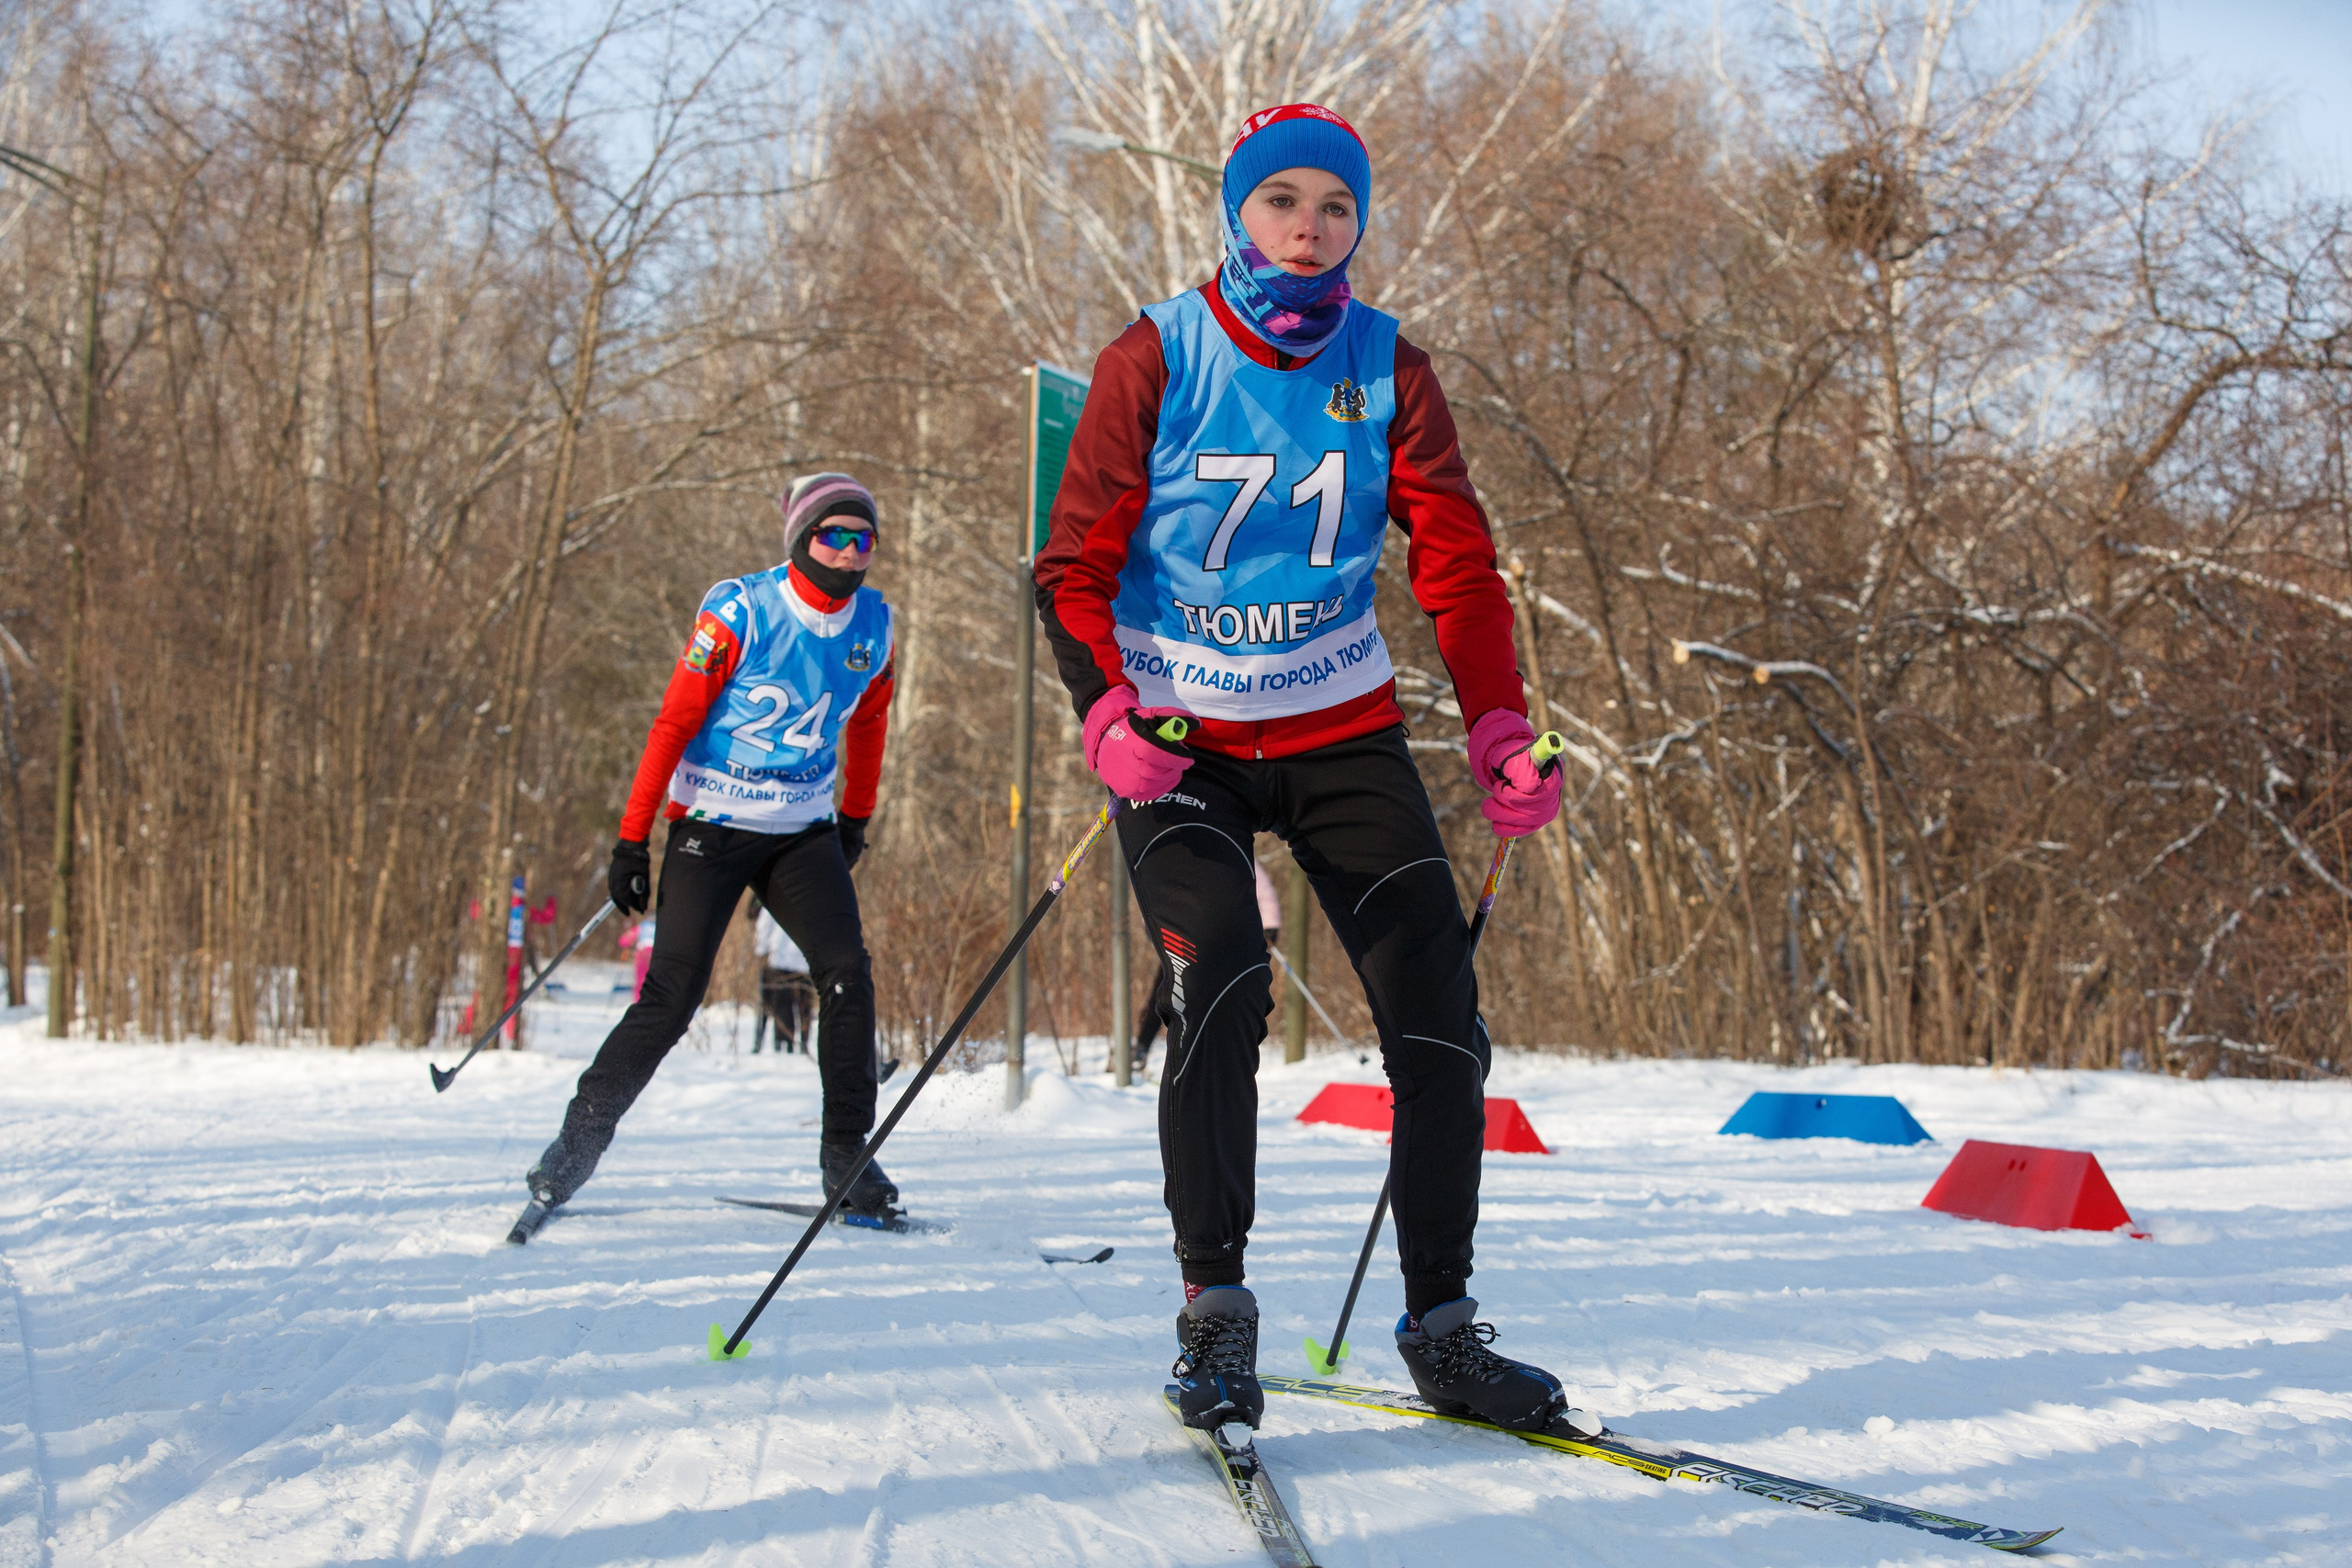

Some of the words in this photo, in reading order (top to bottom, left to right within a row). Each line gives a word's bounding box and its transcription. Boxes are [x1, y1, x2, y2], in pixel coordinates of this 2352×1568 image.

[1195, 450, 1347, 572] 71
[1120, 647, 1179, 680] УБОК
[1182, 663, 1251, 693] ГЛАВЫ
[1260, 656, 1337, 691] ГОРОДА
[685, 773, 727, 795] КУБОК
[729, 784, 775, 801] ГЛАВЫ
[1644, 1463, 1668, 1474] SKATING
[1909, 1511, 1984, 1531] FISCHER
